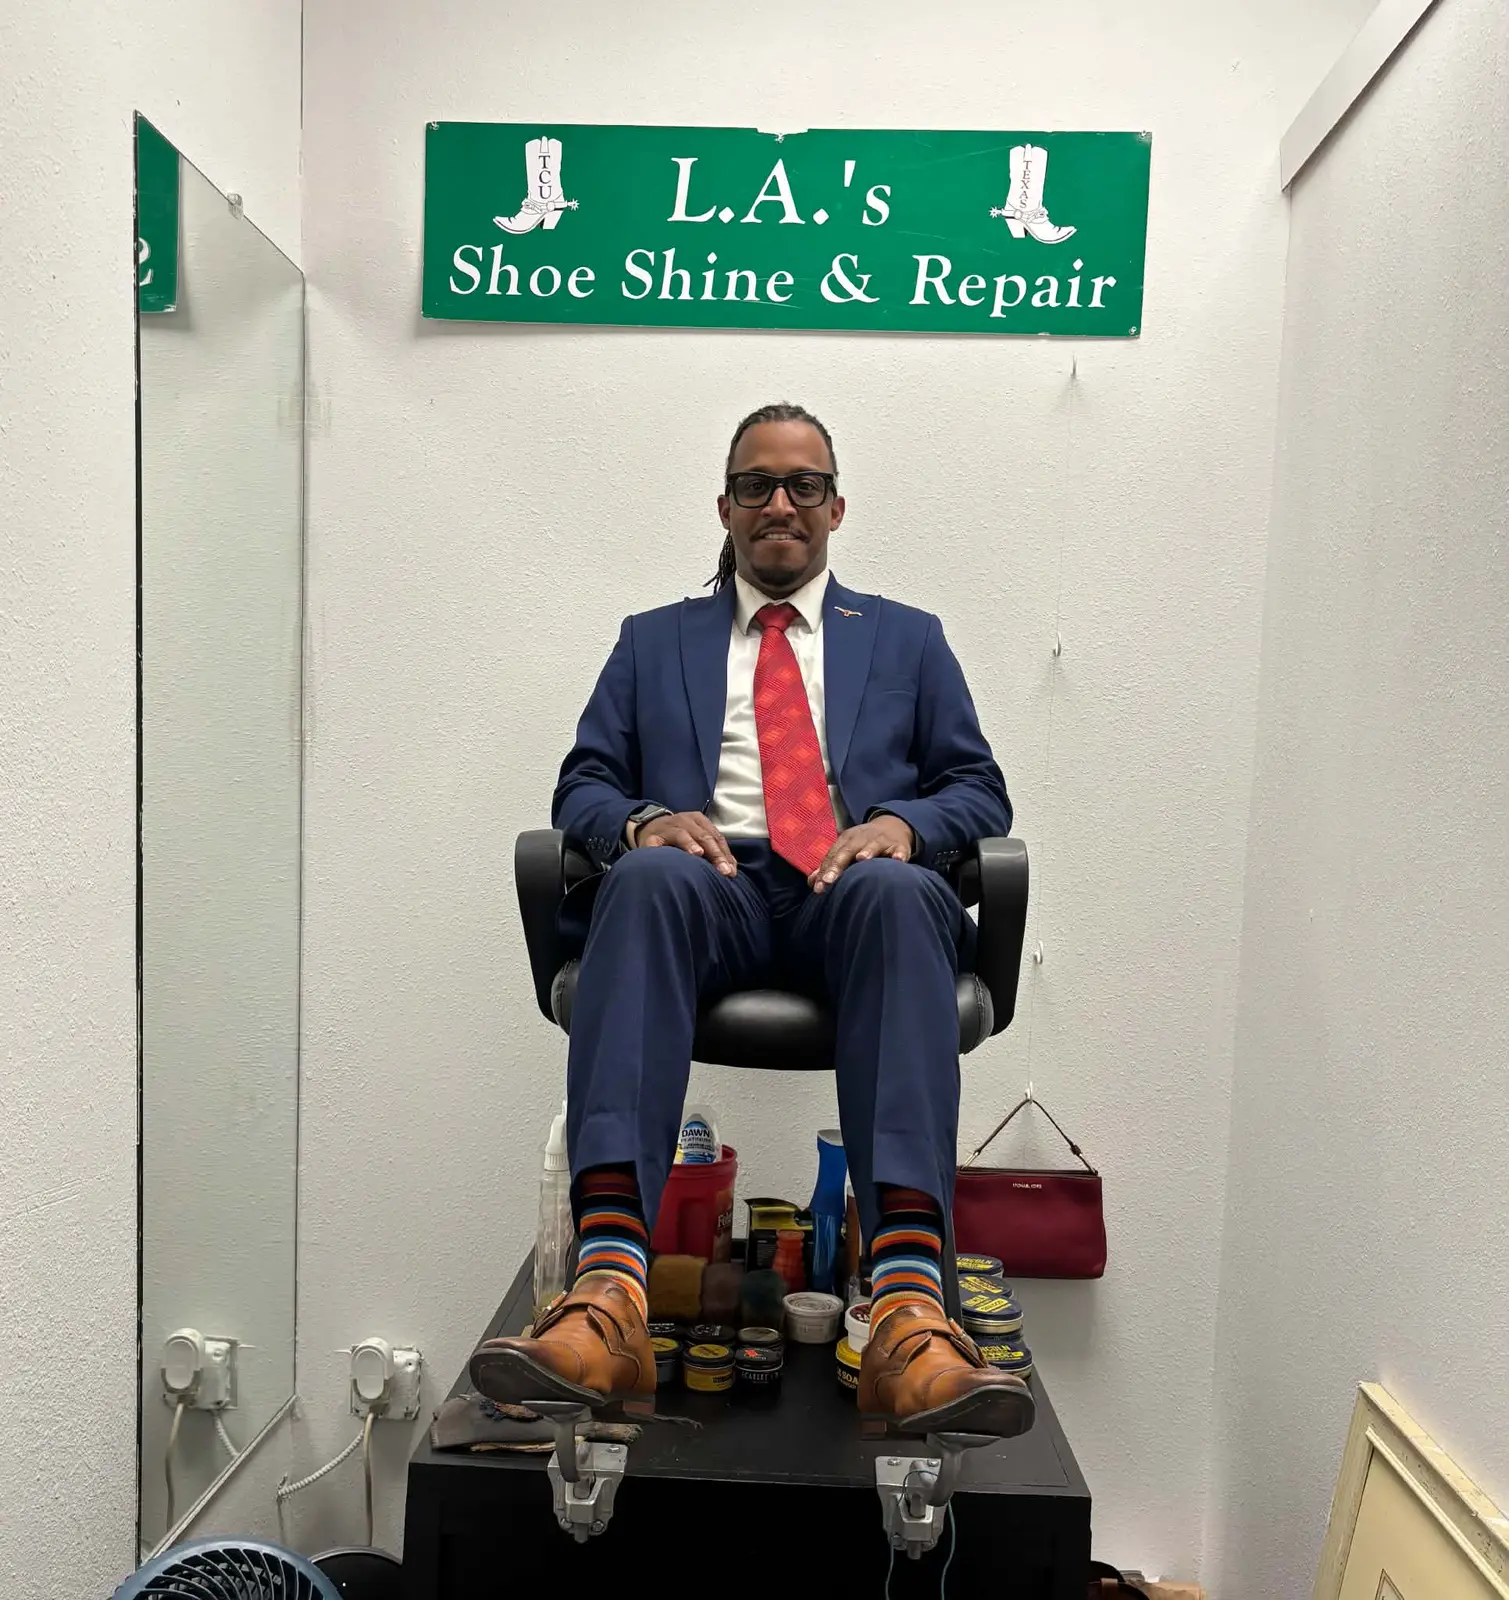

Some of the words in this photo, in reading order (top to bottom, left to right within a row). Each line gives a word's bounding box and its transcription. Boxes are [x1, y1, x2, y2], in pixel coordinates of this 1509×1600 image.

[538, 154, 552, 200] TCU
[1018, 160, 1032, 209] TEXAS
[449, 244, 595, 300] Shoe
[621, 248, 794, 304] Shine
[820, 253, 880, 305] &
[909, 255, 1117, 318] Repair
[681, 1128, 711, 1138] DAWN
